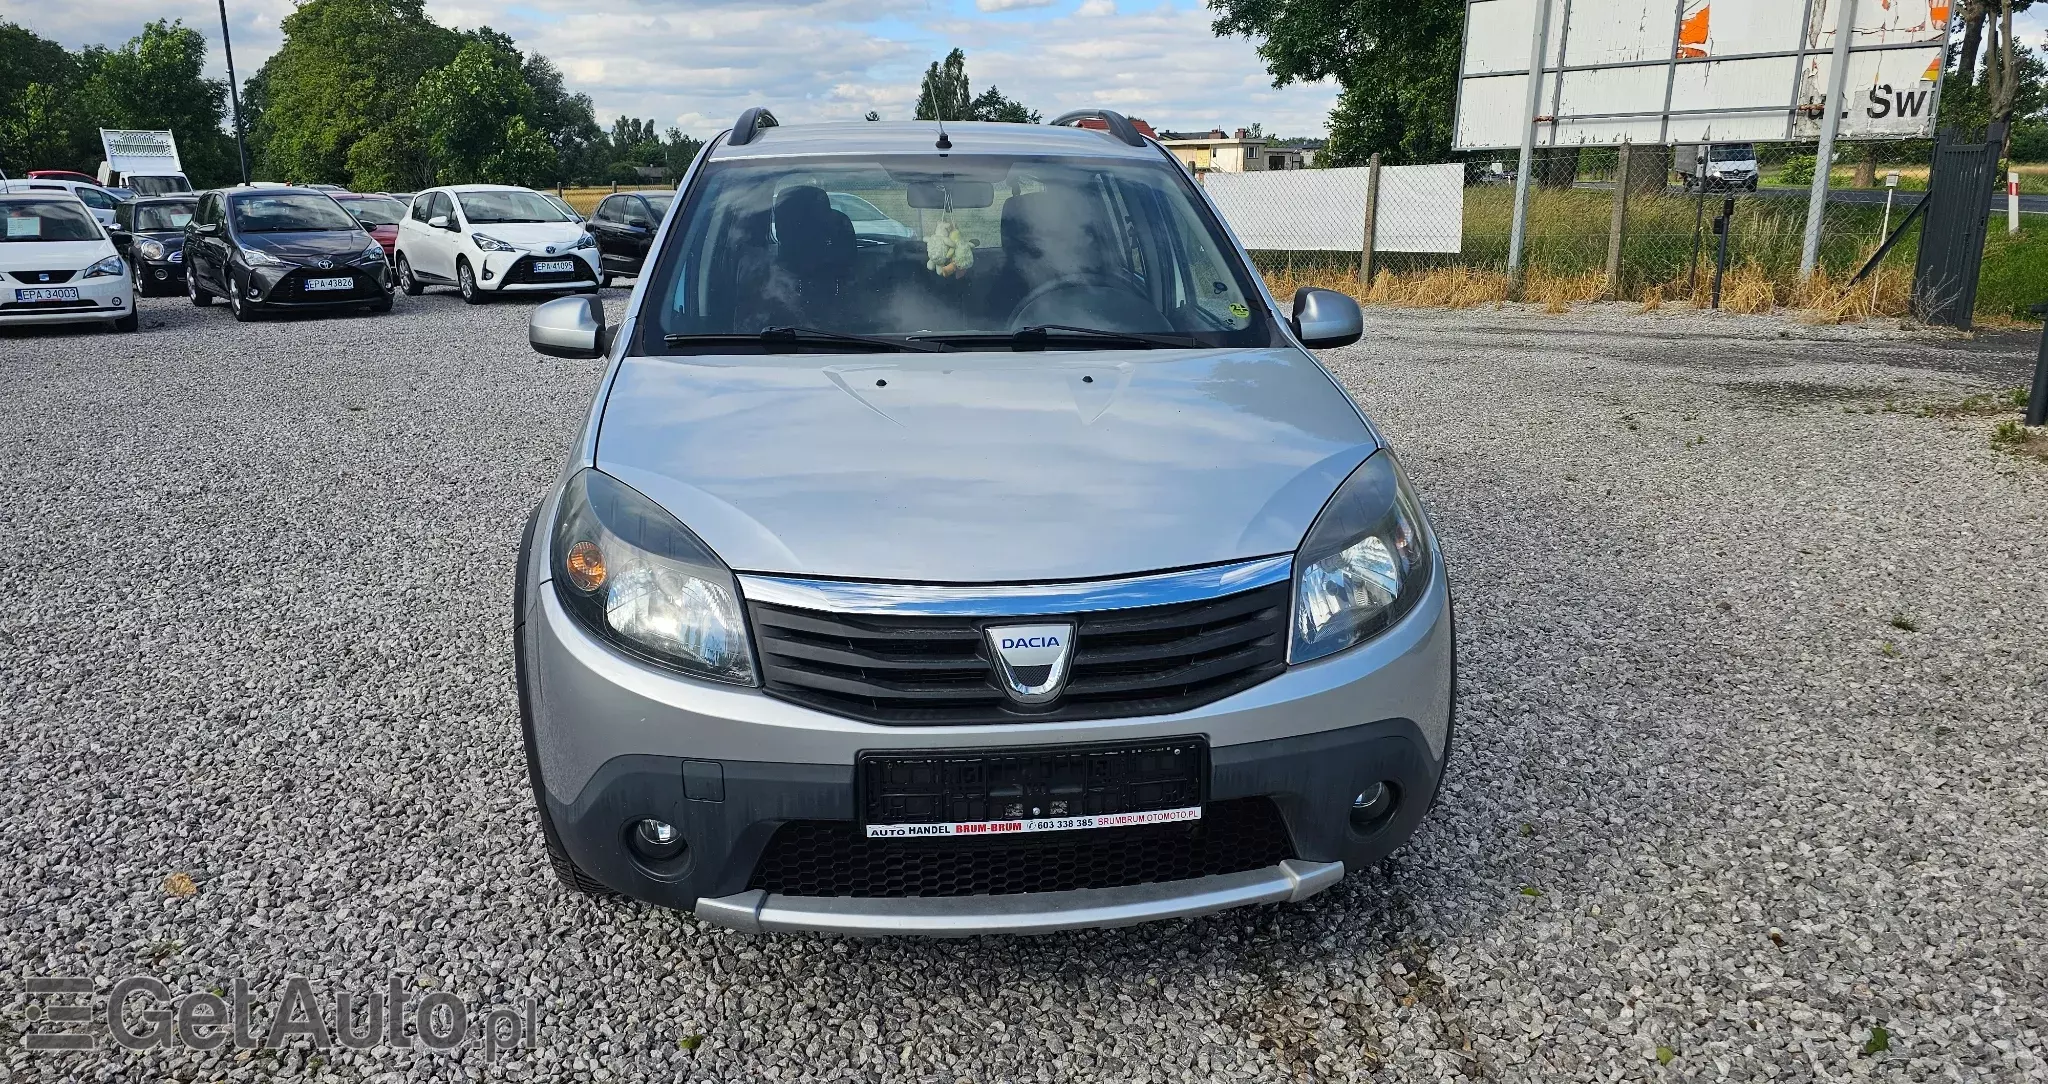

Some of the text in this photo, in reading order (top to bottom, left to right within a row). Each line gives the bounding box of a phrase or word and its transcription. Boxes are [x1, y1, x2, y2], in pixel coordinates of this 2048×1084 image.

[553, 261, 573, 269] 41095
[309, 278, 353, 288] EPA 43826
[22, 288, 77, 300] EPA 34003
[1002, 636, 1060, 649] DACIA
[871, 829, 906, 837] AUTO
[908, 825, 951, 835] HANDEL
[955, 822, 1022, 834] BRUM-BRUM
[1037, 820, 1054, 829] 603
[1056, 818, 1074, 828] 338
[1076, 818, 1093, 827] 385
